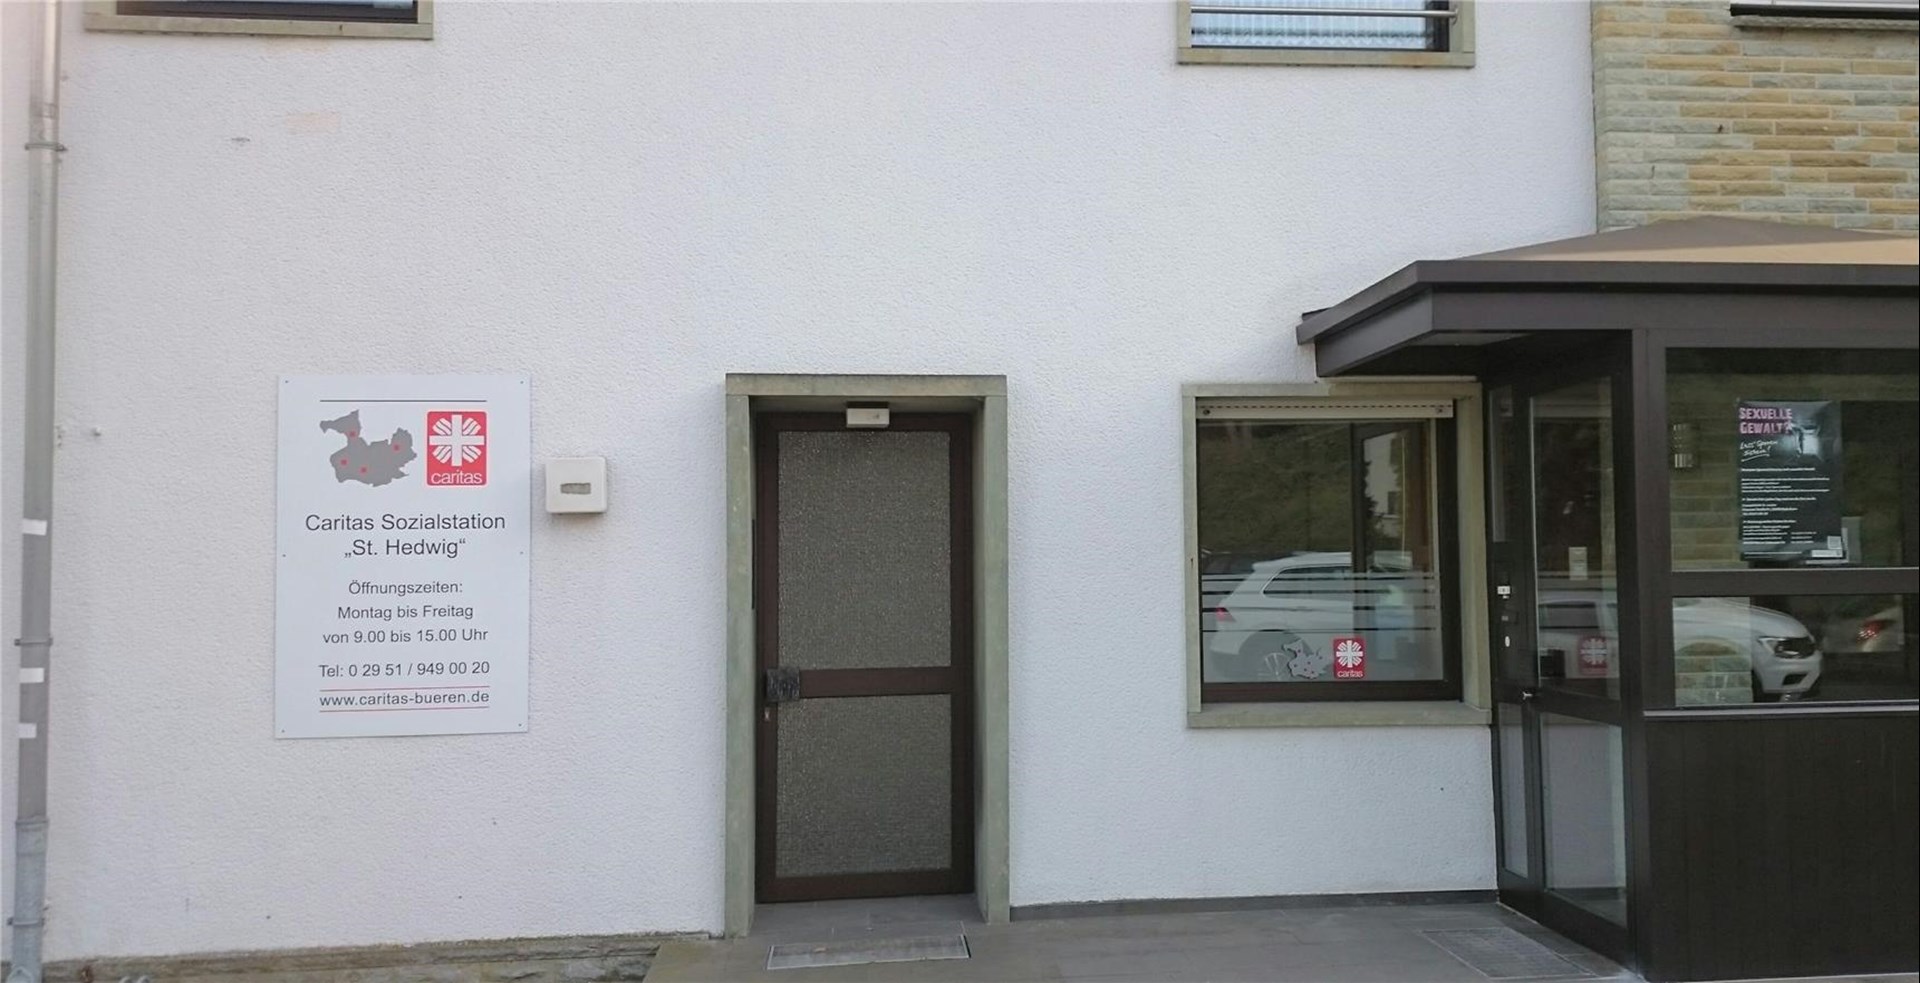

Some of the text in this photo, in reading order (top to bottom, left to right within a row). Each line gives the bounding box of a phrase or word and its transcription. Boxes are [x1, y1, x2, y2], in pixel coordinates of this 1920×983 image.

[1739, 407, 1792, 419] SEXUELLE
[431, 469, 483, 484] caritas
[305, 513, 505, 531] Caritas Sozialstation
[344, 538, 467, 558] „St. Hedwig“
[349, 580, 463, 597] Öffnungszeiten:
[338, 605, 473, 621] Montag bis Freitag
[323, 628, 488, 643] von 9.00 bis 15.00 Uhr
[319, 661, 490, 677] Tel: 0 29 51 / 949 00 20
[319, 691, 489, 706] www.caritas-bueren.de
